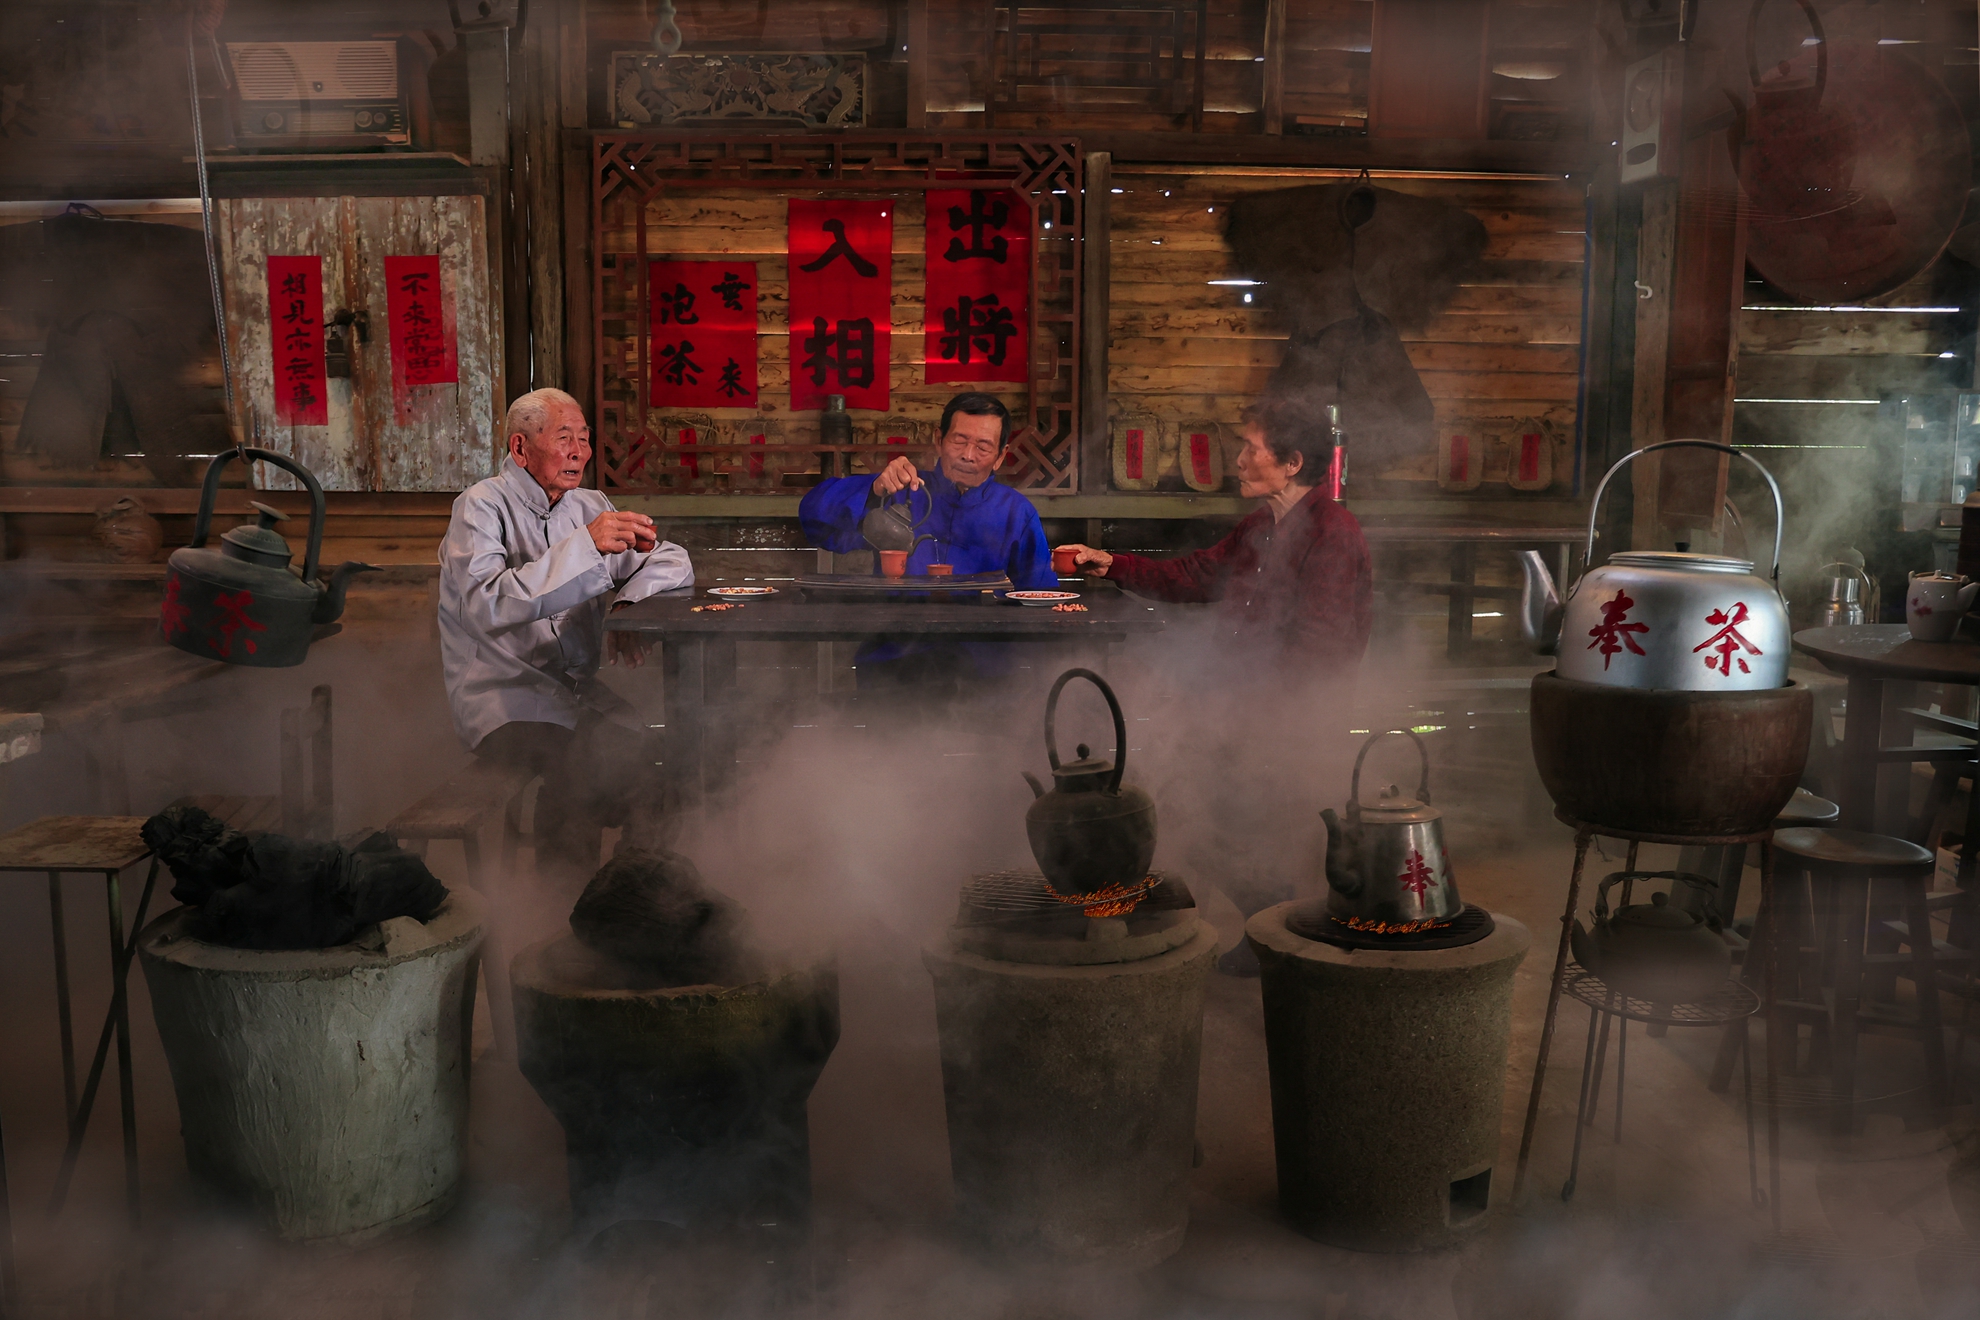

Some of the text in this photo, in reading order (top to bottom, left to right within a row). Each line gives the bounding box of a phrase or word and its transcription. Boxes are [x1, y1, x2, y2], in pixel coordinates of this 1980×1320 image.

[798, 217, 880, 390] 入相
[939, 189, 1019, 367] 出將
[1586, 588, 1764, 678] 奉茶
